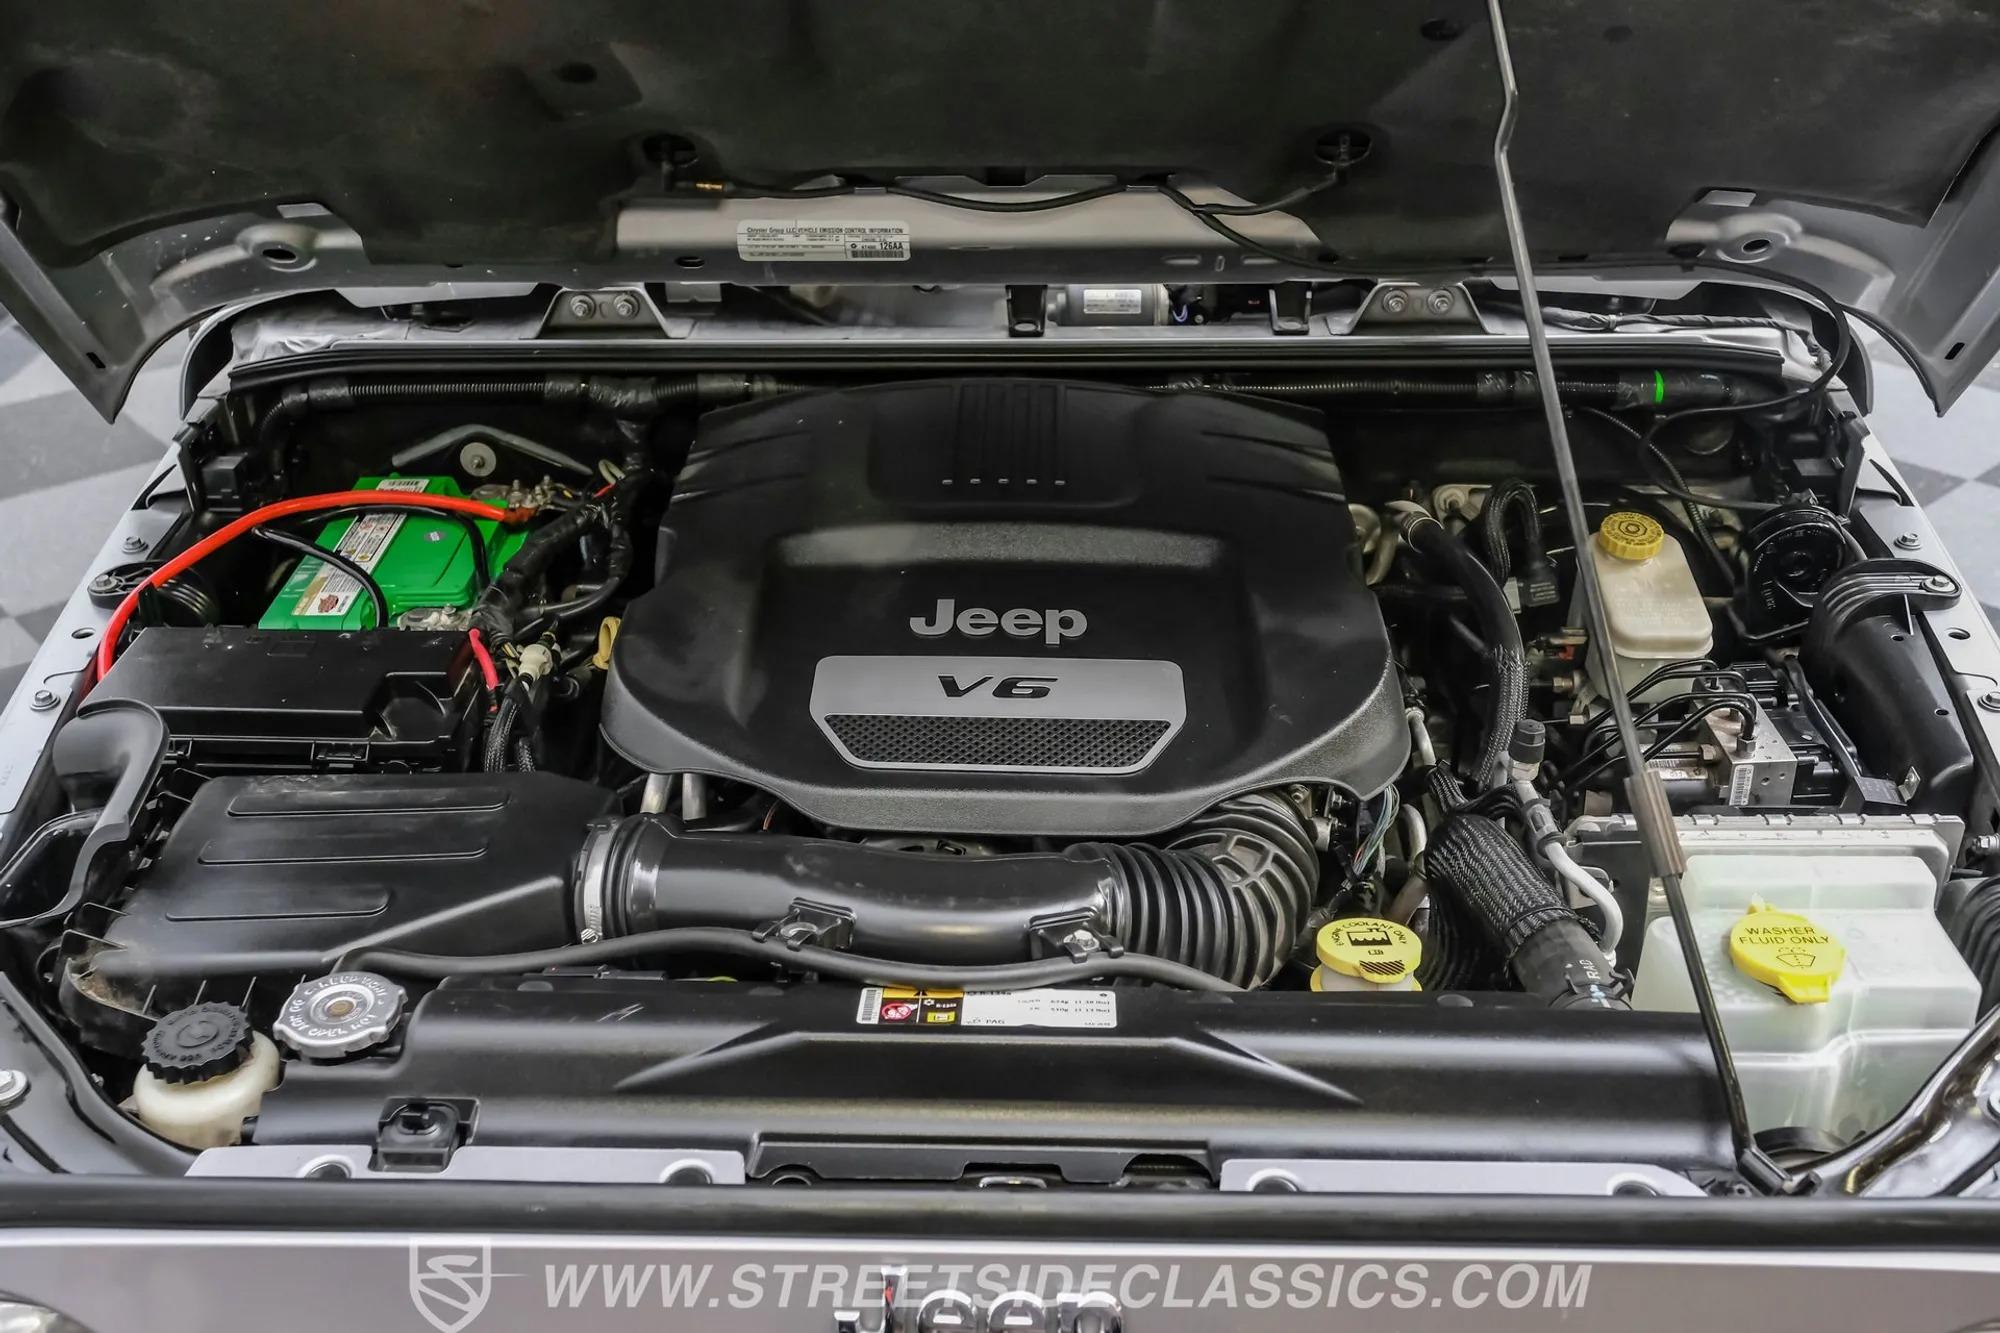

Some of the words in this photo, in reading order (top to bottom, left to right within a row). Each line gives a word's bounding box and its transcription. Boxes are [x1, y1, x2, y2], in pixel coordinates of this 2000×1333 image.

[880, 242, 904, 250] 126AA
[909, 598, 1088, 645] Jeep
[937, 674, 1059, 699] V6
[1342, 921, 1395, 930] COOLANT
[1744, 926, 1816, 935] WASHER
[1739, 936, 1785, 945] FLUID
[1790, 936, 1829, 944] ONLY
